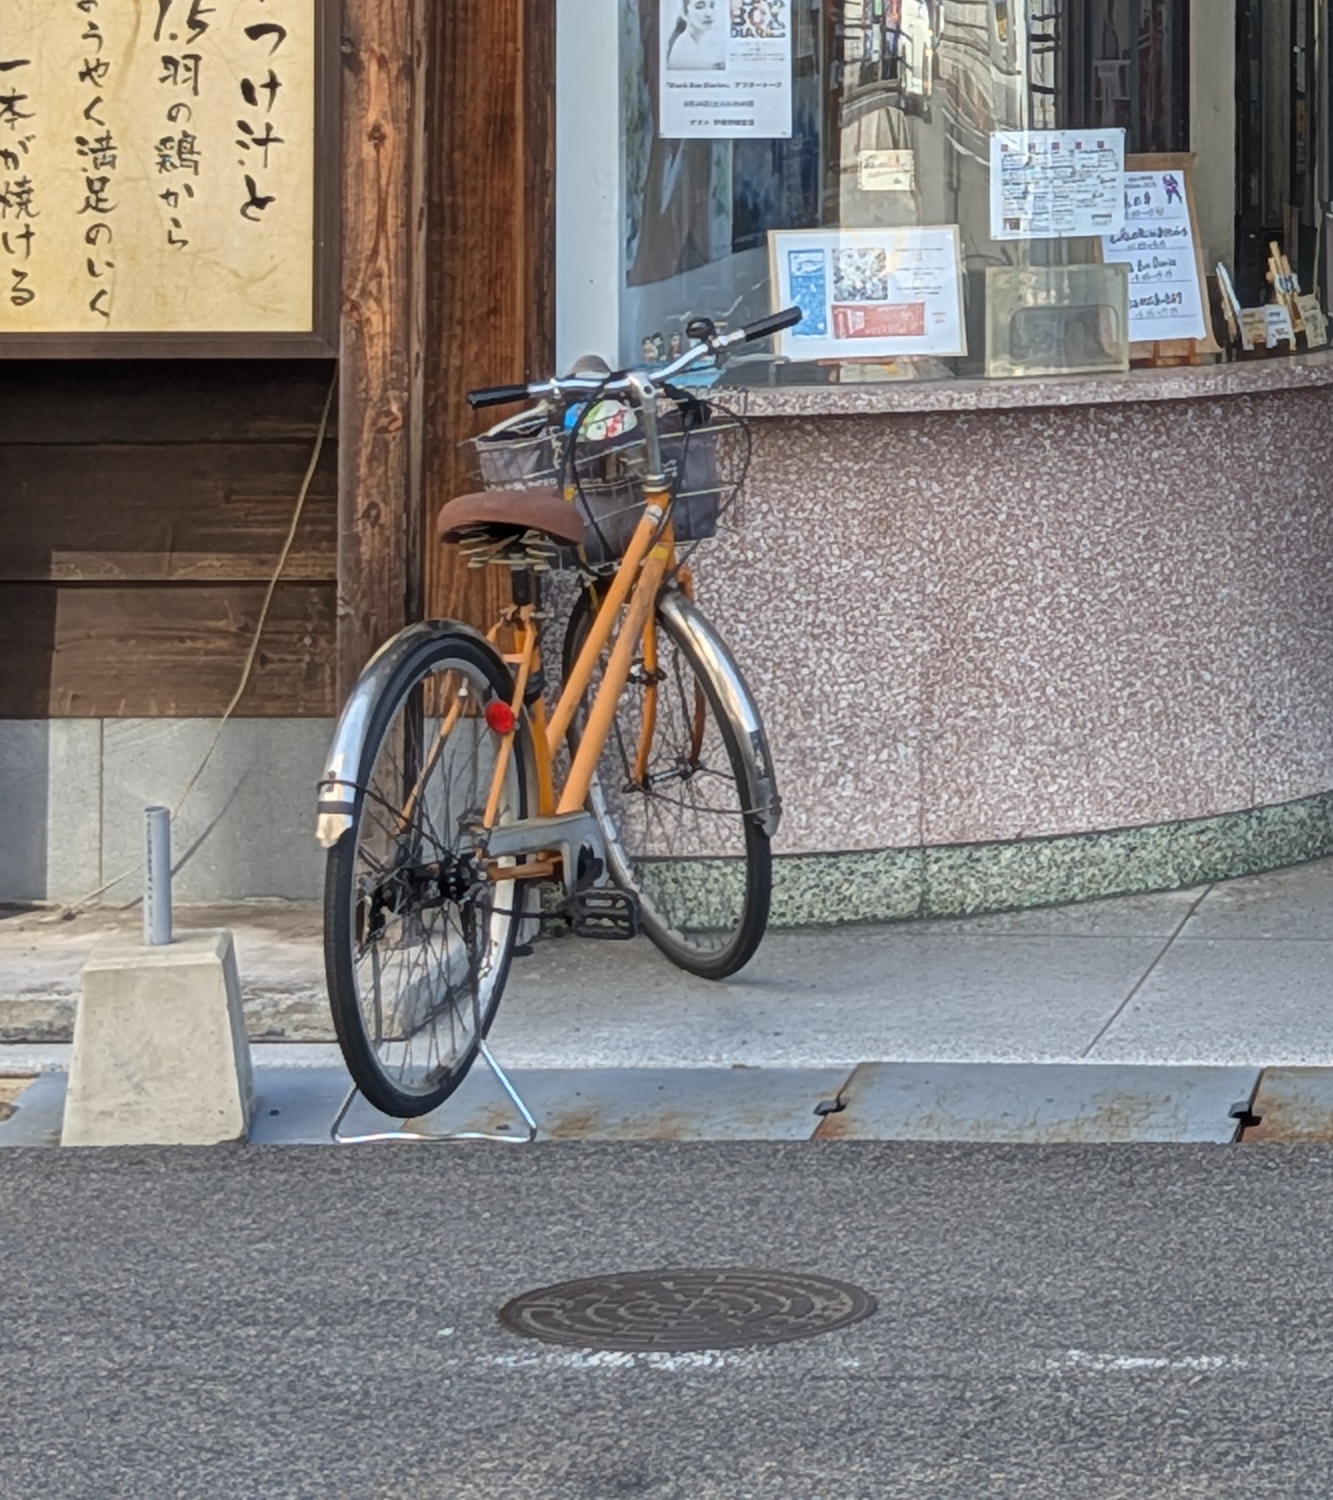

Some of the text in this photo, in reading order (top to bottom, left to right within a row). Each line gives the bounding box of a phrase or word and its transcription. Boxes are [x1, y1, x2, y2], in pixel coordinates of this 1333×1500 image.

[0, 58, 41, 306] 一本が焼ける
